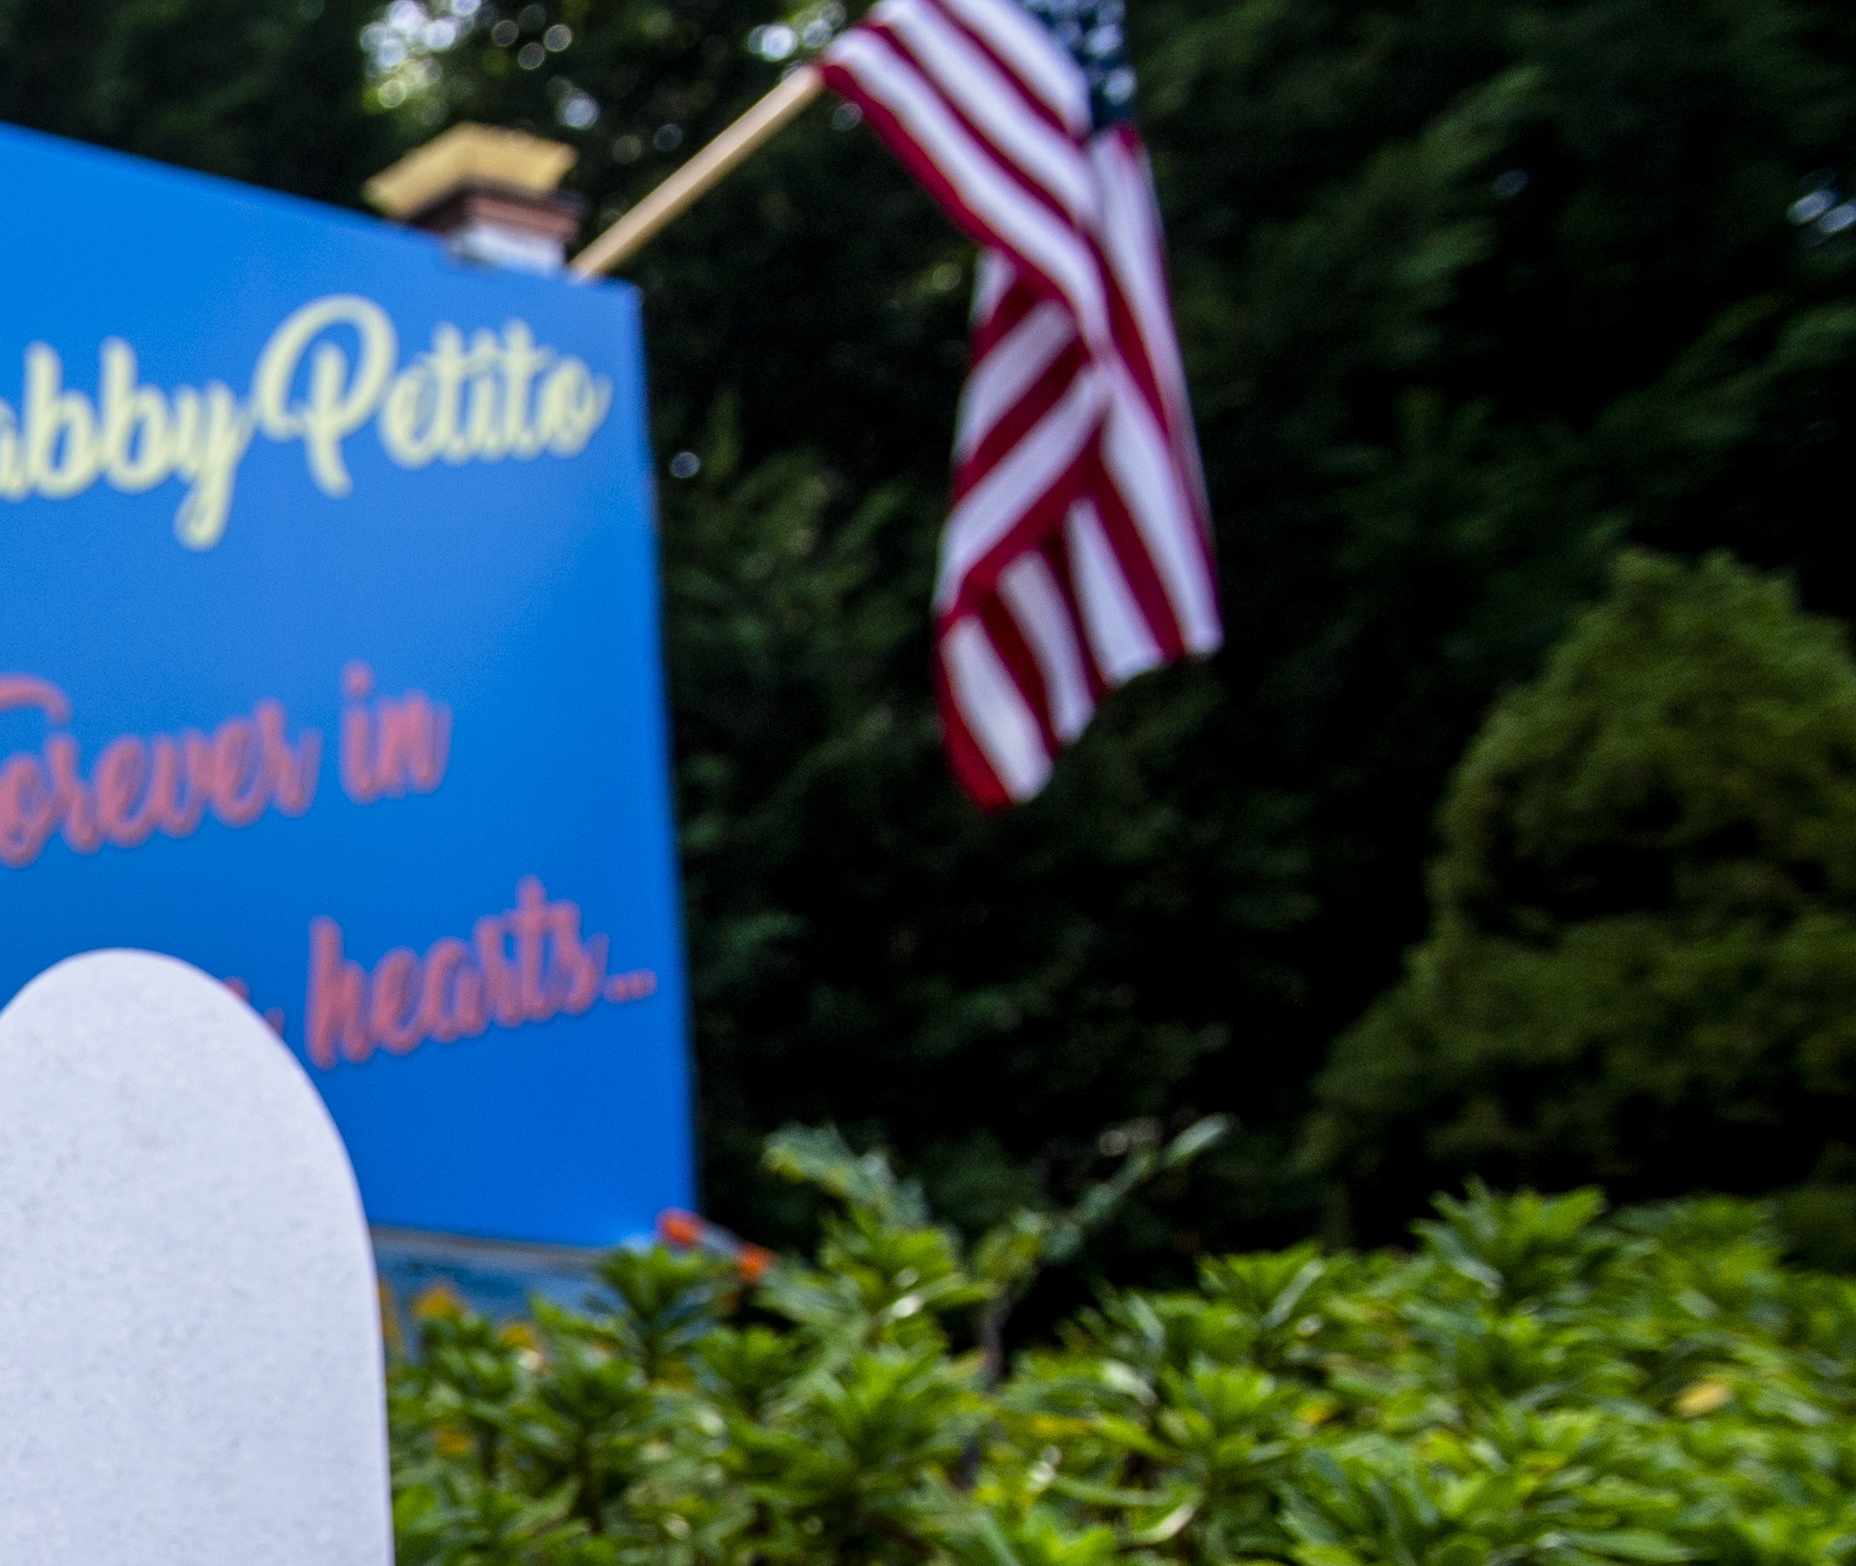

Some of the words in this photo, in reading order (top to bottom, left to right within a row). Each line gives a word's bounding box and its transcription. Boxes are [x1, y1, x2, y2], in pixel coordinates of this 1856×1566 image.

[250, 293, 614, 497] Petito
[339, 661, 452, 803] in
[303, 876, 659, 1072] hearts...
